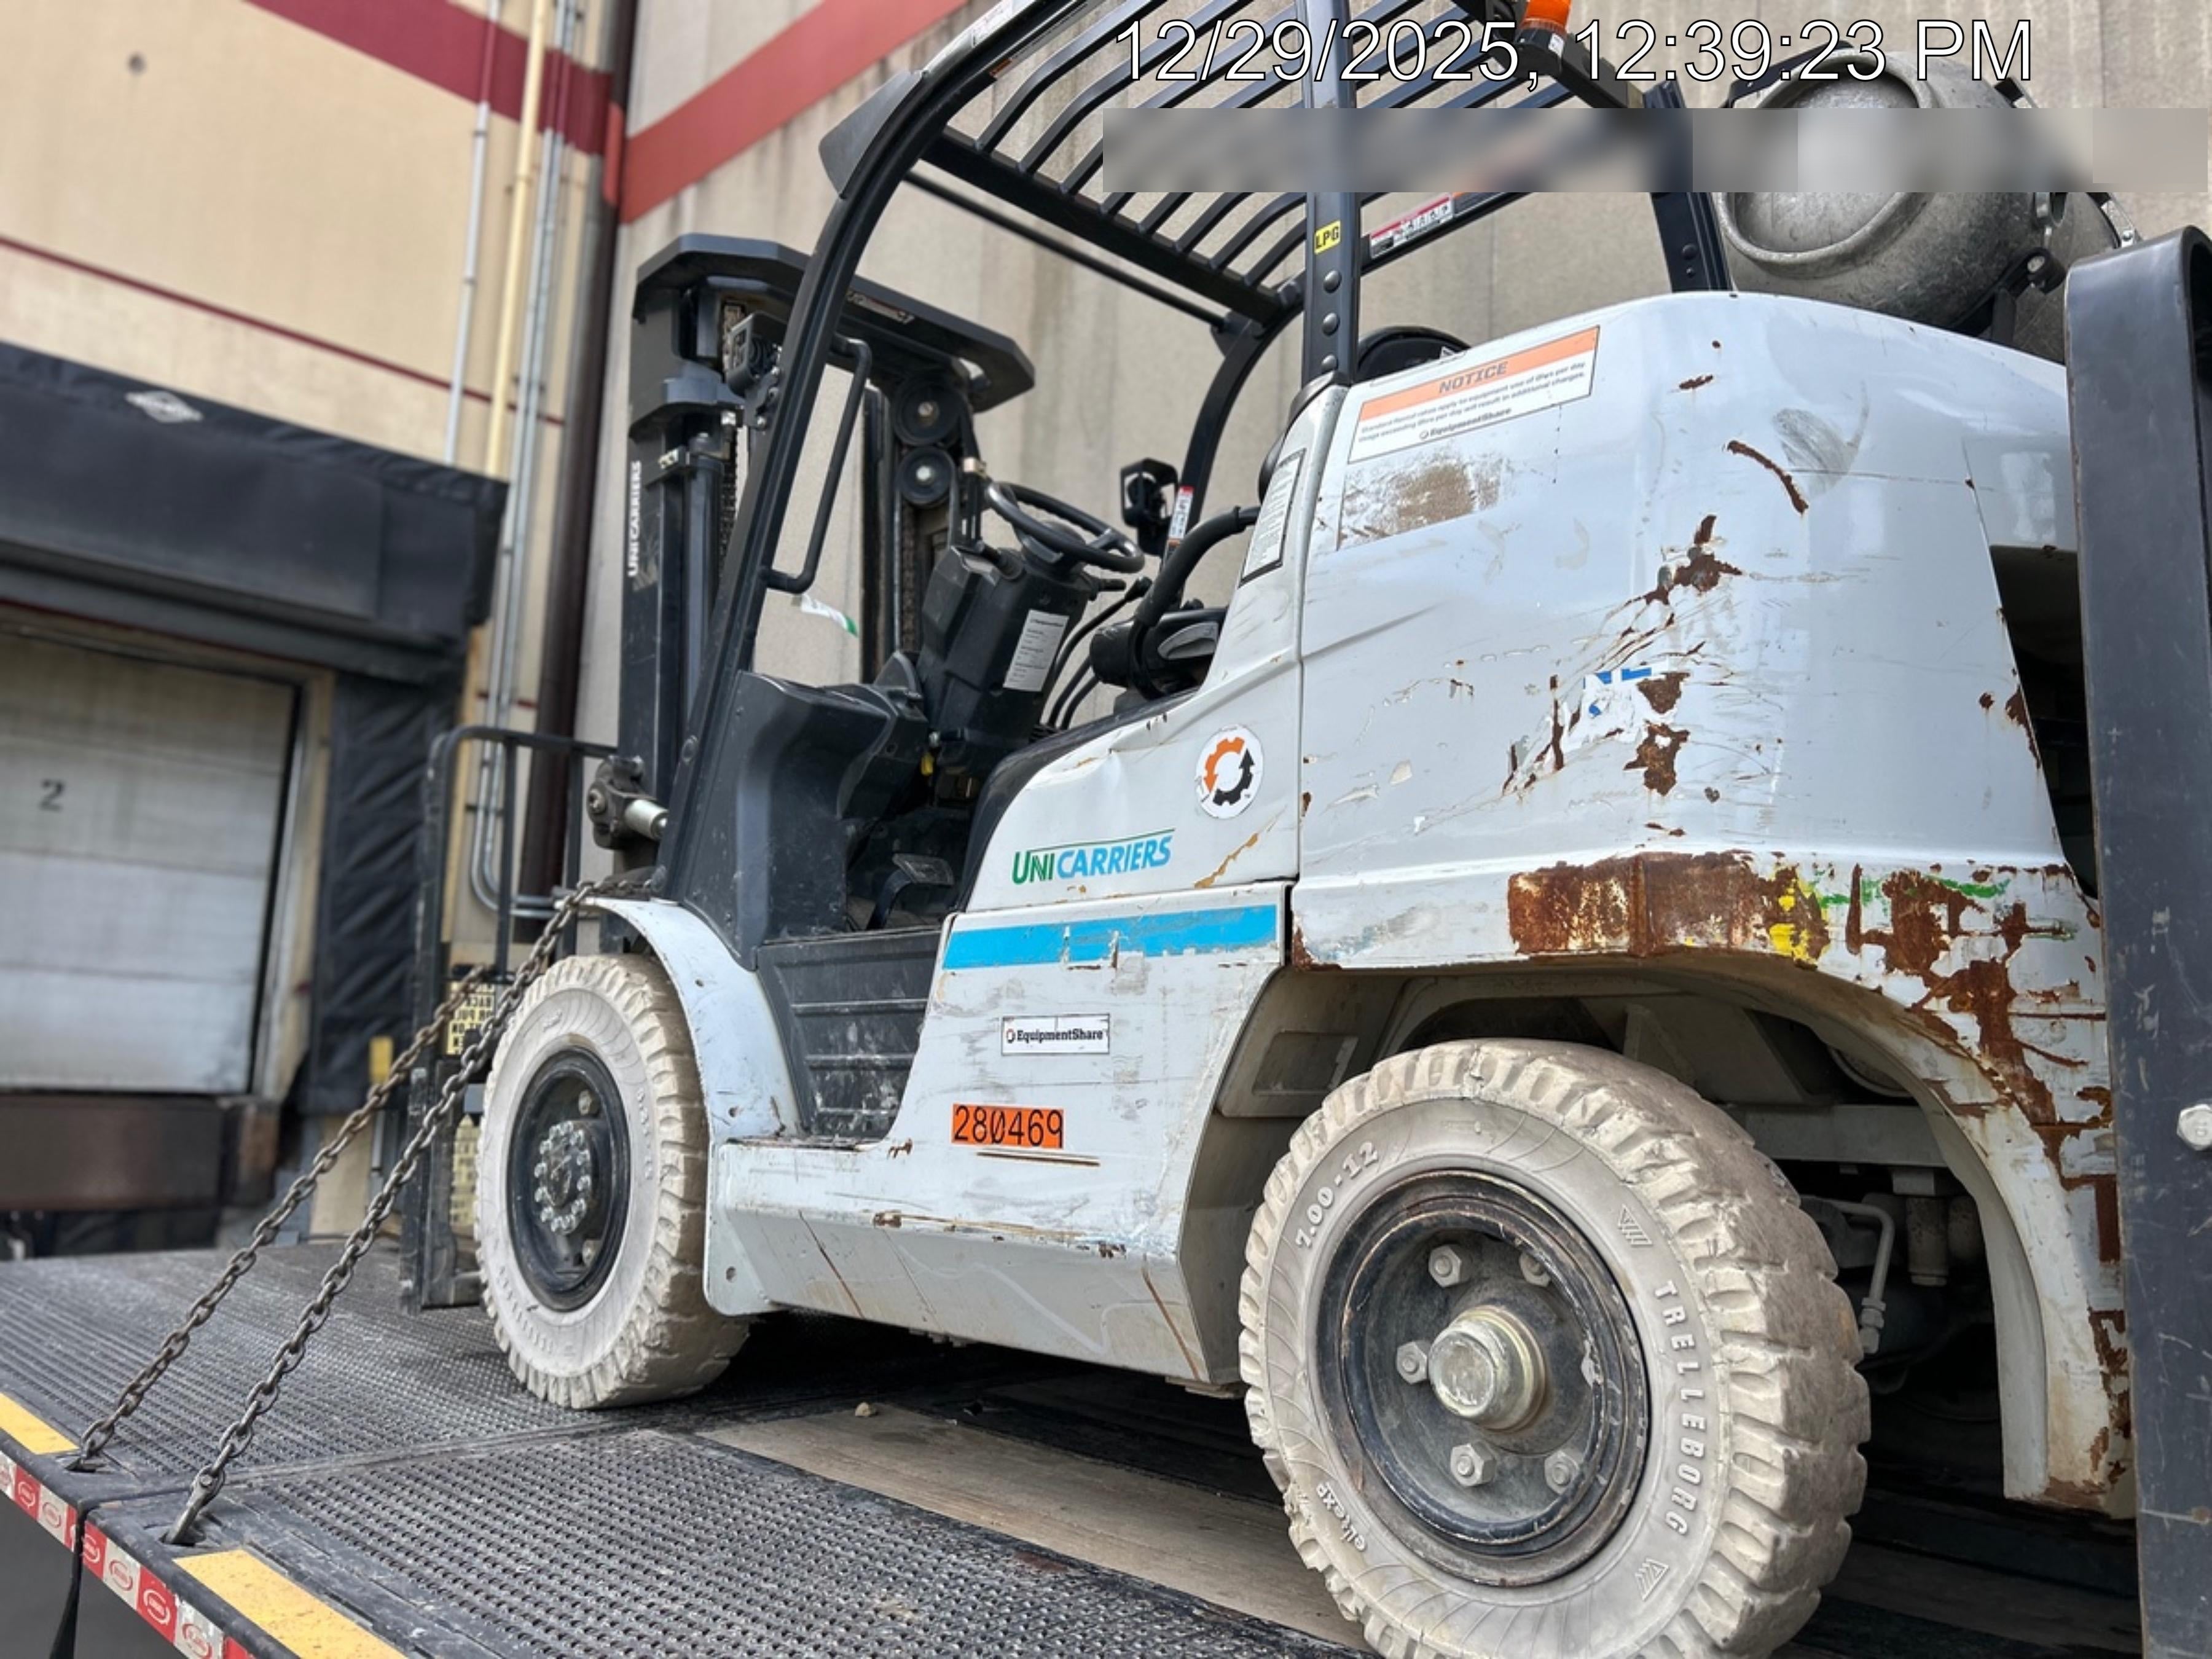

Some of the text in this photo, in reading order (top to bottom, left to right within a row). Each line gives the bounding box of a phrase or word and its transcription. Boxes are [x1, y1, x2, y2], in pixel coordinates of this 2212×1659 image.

[1315, 226, 1339, 248] LPG
[1439, 363, 1507, 394] NOTICE
[38, 778, 66, 812] 2
[1016, 1028, 1104, 1044] EquipmentShare
[954, 1105, 1064, 1148] 280469
[1654, 1279, 1708, 1535] TRELLEBORG
